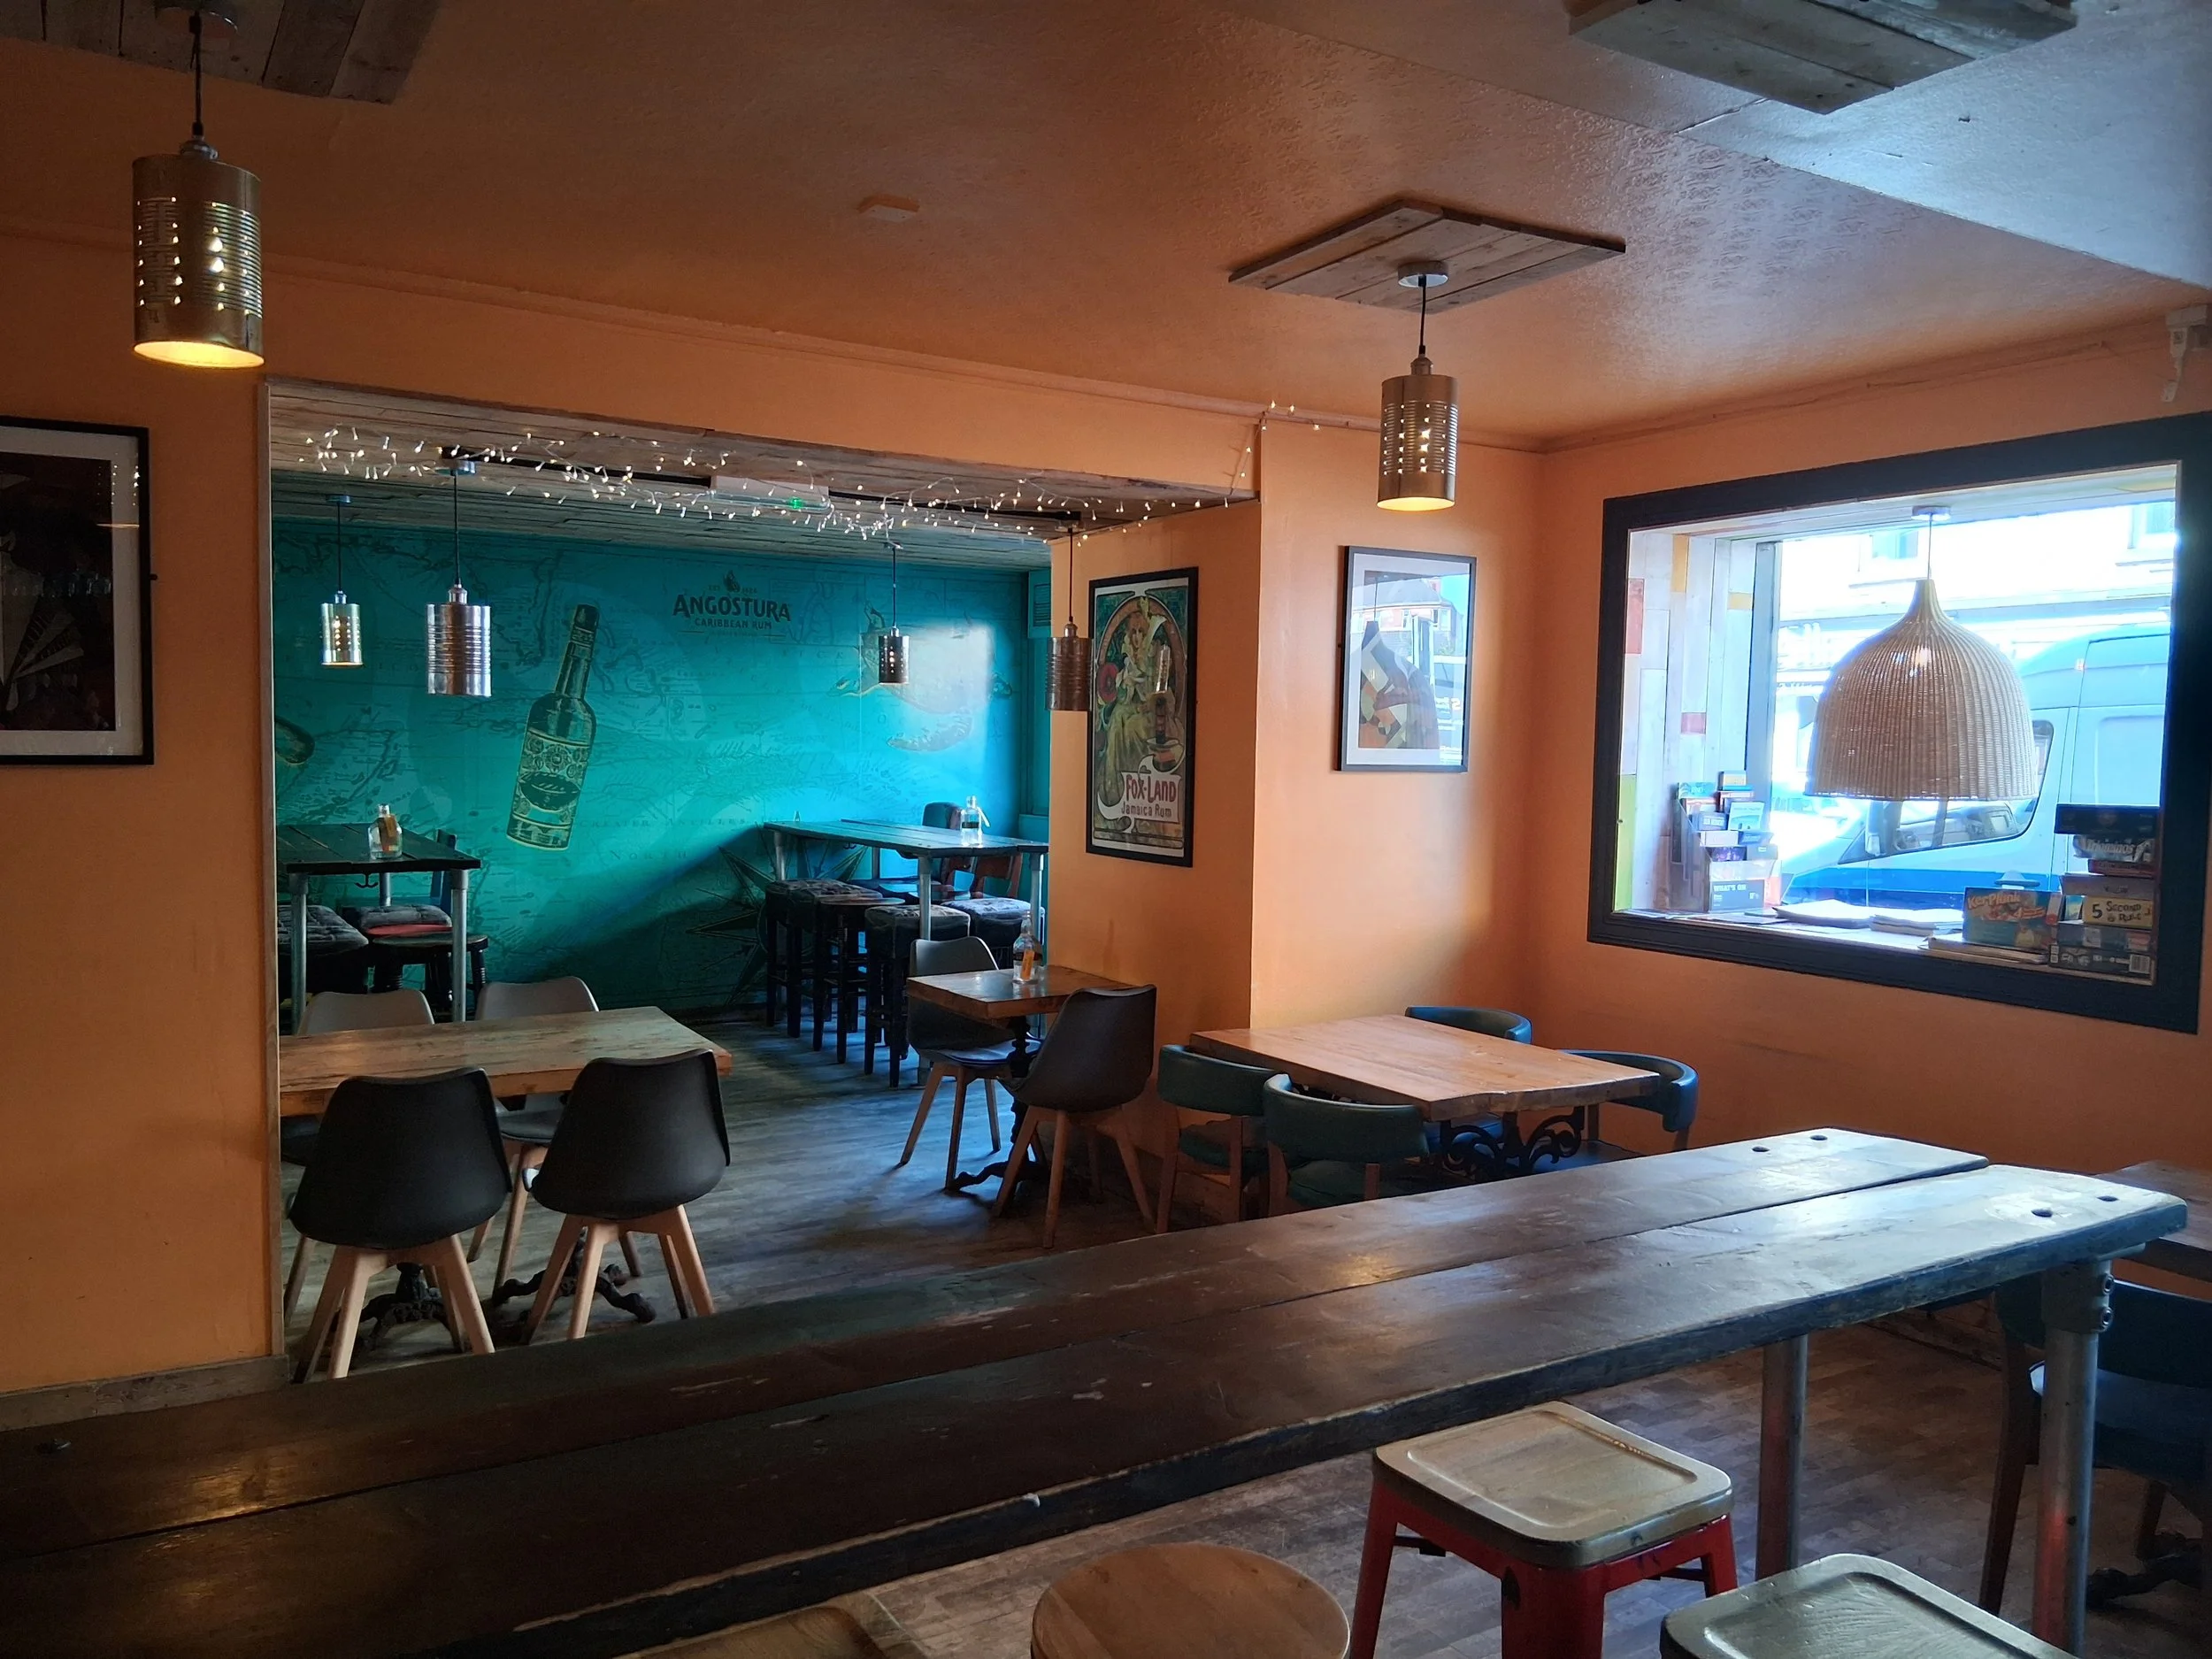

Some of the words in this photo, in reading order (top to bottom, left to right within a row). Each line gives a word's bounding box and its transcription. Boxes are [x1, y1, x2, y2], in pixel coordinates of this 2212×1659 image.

[672, 595, 791, 622] ANGOSTURA
[695, 618, 749, 629] CARIBBEAN
[753, 619, 772, 630] RUM
[1121, 802, 1153, 815] Jamaica
[1154, 803, 1172, 818] Rum
[2092, 903, 2103, 919] 5
[2106, 901, 2142, 912] SECOND
